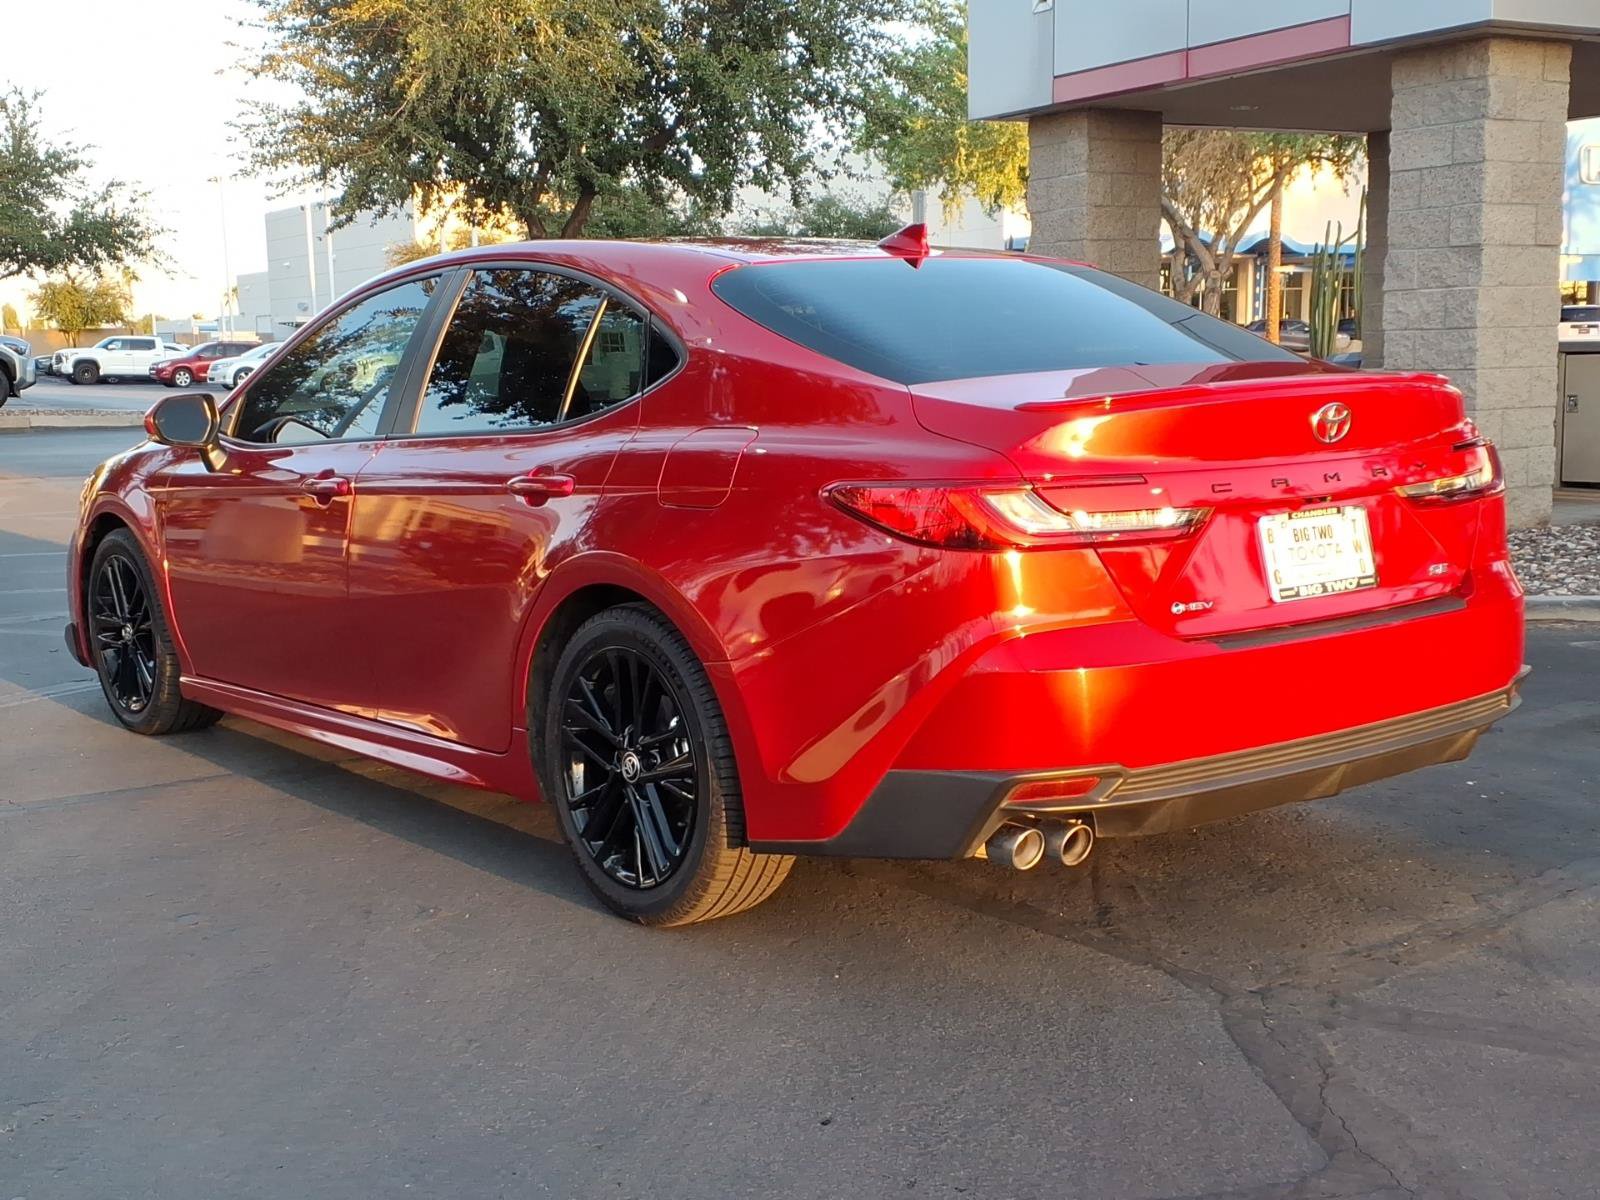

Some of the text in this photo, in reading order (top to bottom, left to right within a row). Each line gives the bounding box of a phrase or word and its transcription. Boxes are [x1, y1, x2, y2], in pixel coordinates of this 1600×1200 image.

[1211, 462, 1425, 494] CAMRY
[1291, 507, 1338, 519] CHANDLER
[1293, 524, 1334, 542] BIG TWO
[1288, 543, 1342, 561] TOYOTA
[1299, 577, 1359, 596] BIG TWO
